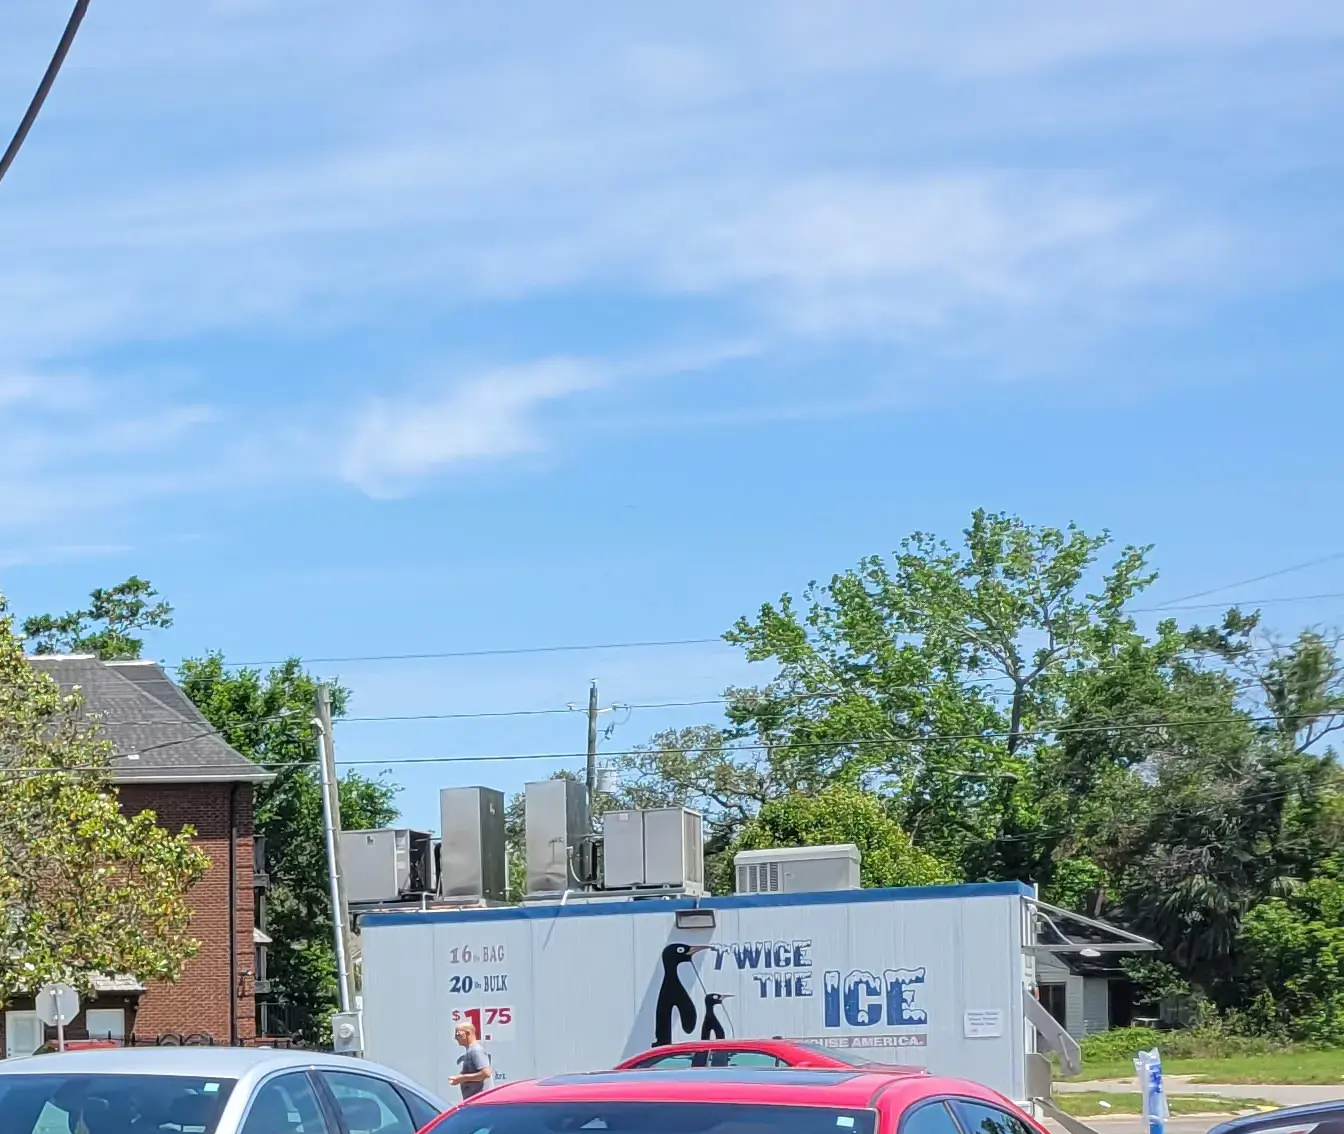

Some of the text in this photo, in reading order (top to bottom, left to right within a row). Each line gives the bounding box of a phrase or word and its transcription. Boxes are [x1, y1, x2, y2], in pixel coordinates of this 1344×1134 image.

[449, 945, 472, 964] 16
[482, 945, 505, 962] BAG
[711, 939, 813, 970] TWICE
[449, 975, 474, 993] 20
[483, 974, 508, 993] BULK
[753, 971, 813, 998] THE
[823, 967, 928, 1027] ICE
